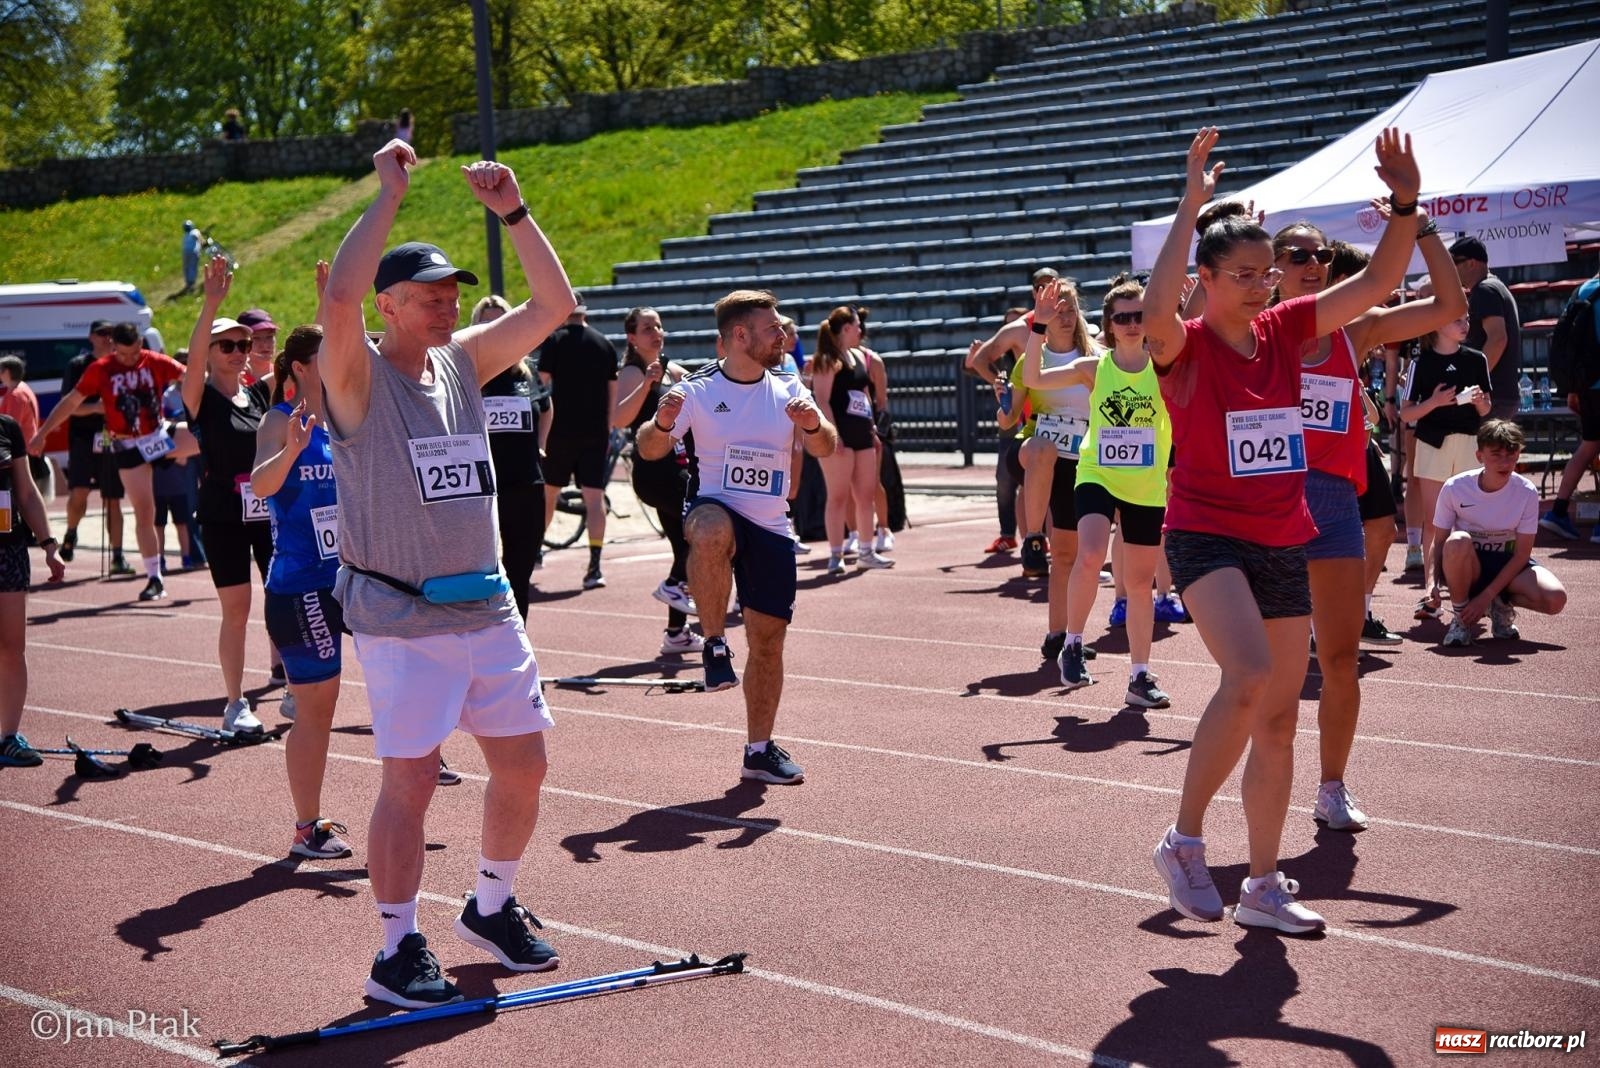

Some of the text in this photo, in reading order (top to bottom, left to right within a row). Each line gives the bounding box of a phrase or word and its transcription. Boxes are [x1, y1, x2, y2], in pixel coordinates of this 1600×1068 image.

[1513, 184, 1569, 209] OSiR
[1476, 221, 1552, 241] ZAWODÓW
[110, 367, 154, 396] RUN
[489, 411, 519, 425] 252
[1301, 398, 1330, 421] 58
[1041, 430, 1069, 447] 074
[1105, 444, 1139, 460] 067
[1239, 436, 1288, 464] 042
[428, 463, 471, 491] 257
[731, 466, 769, 487] 039
[252, 499, 269, 513] 25
[303, 591, 336, 659] UNNERS
